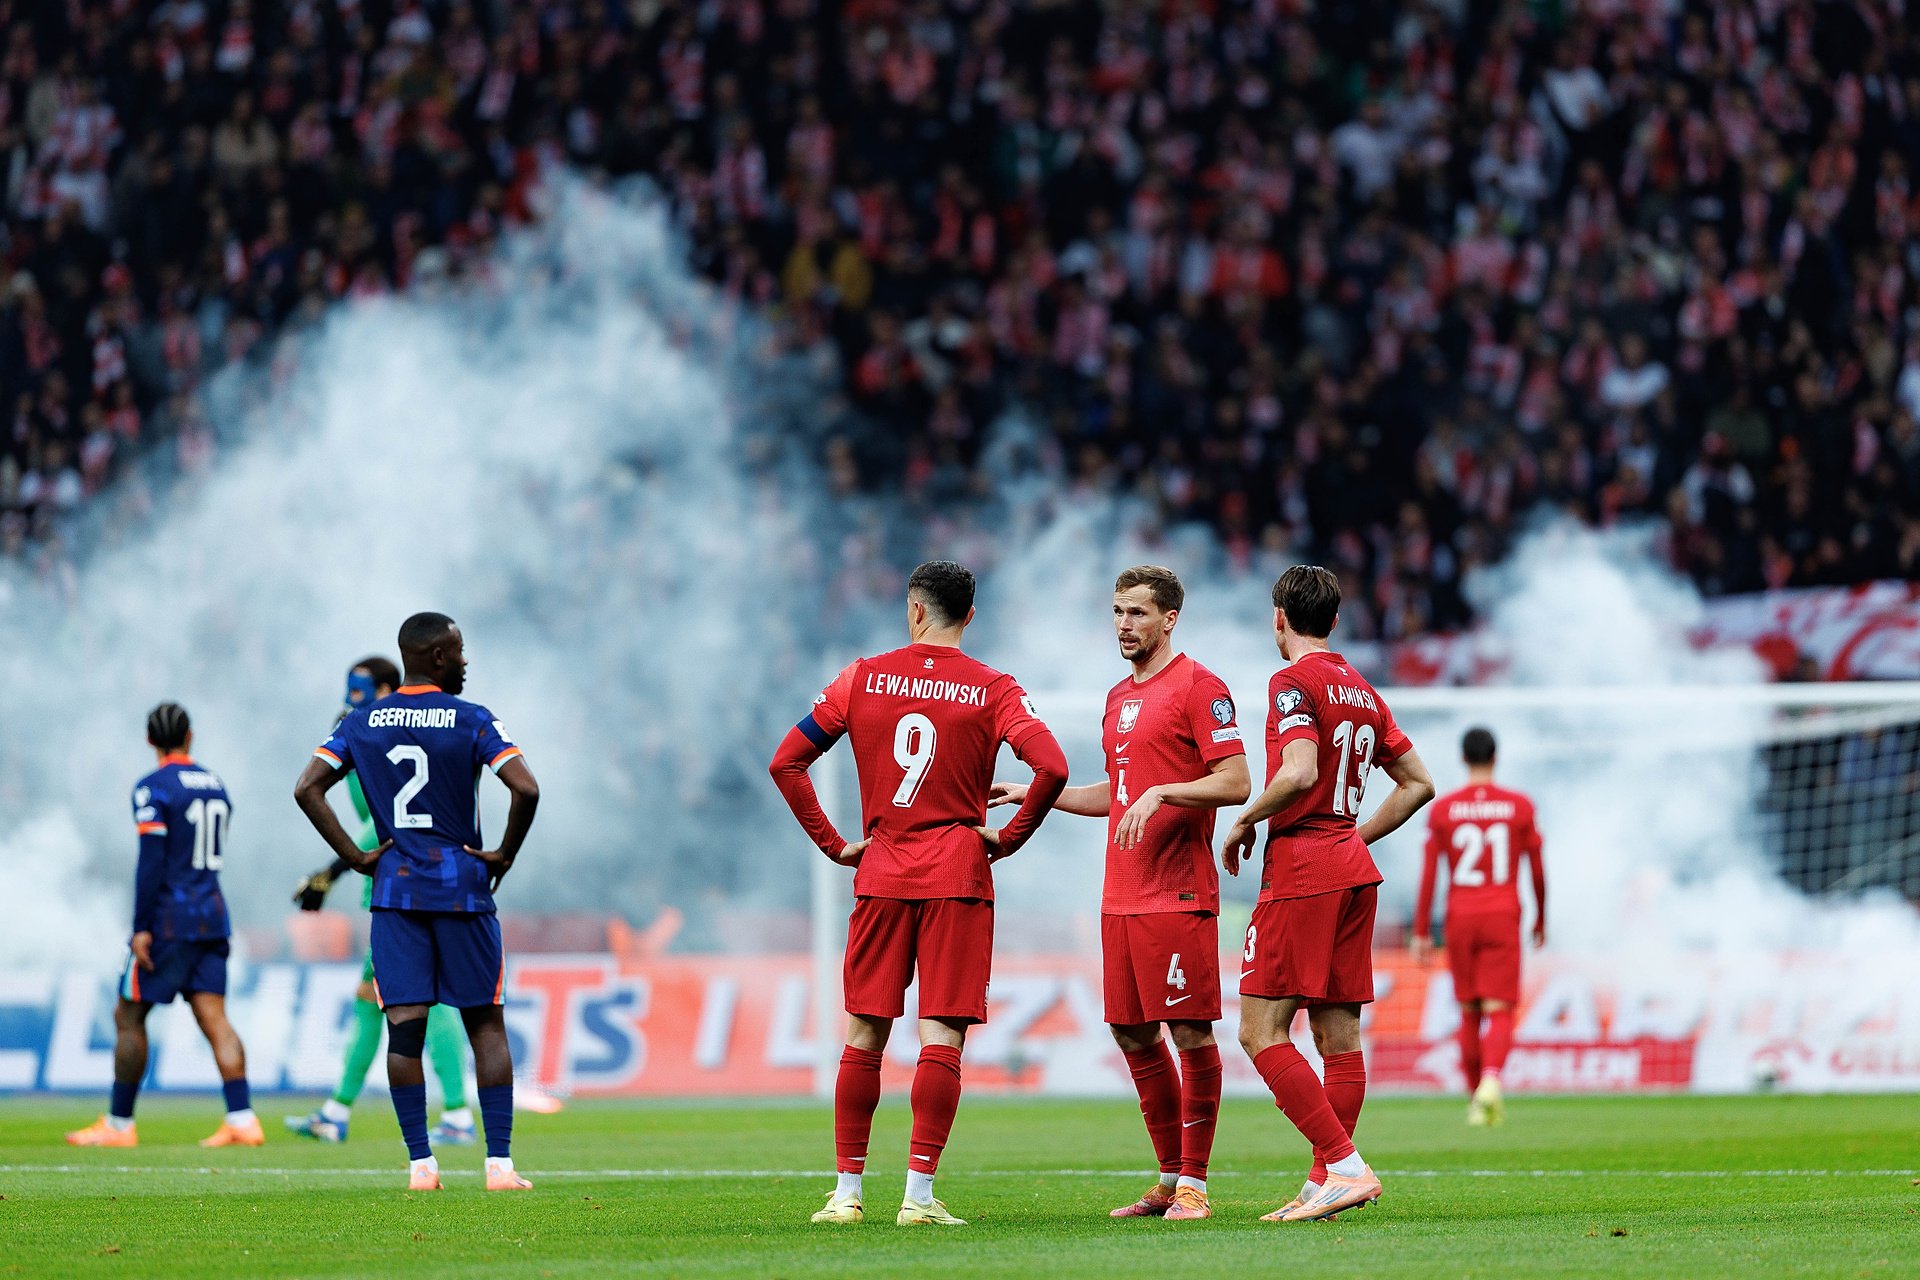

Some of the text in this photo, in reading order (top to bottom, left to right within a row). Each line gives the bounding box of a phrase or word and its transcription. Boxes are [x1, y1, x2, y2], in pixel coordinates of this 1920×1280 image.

[368, 707, 457, 728] GEERTRUIDA
[866, 673, 987, 706] LEWANDOWSKI
[386, 744, 433, 829] 2
[893, 713, 937, 808] 9
[1117, 769, 1129, 806] 4
[1333, 720, 1375, 815] 13
[184, 798, 229, 871] 10
[1452, 822, 1510, 887] 21
[1167, 953, 1186, 989] 4
